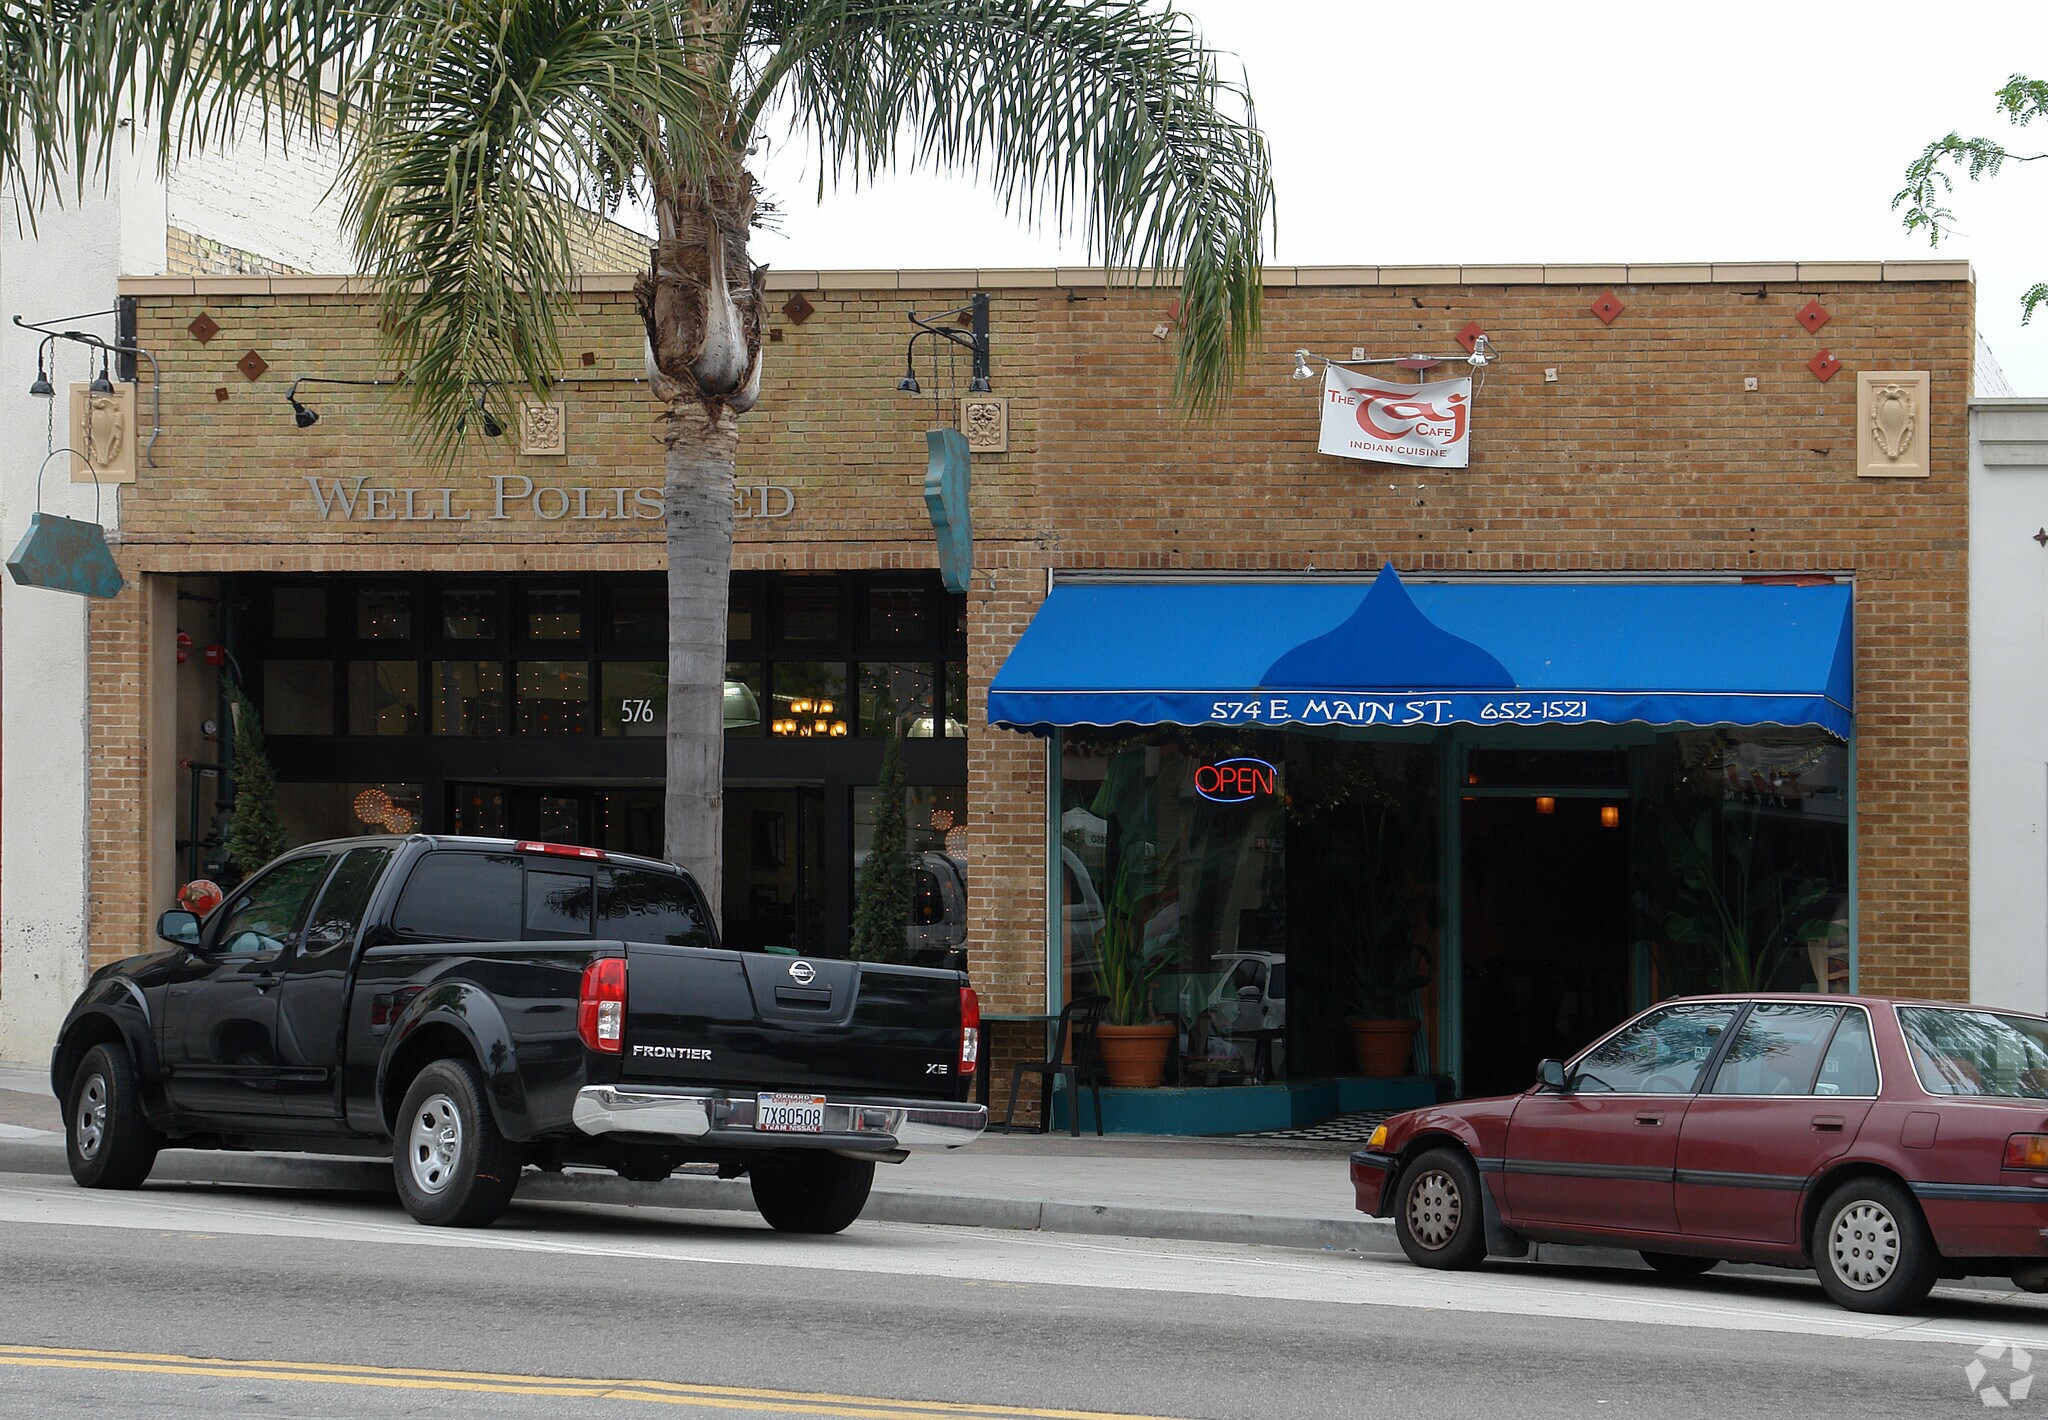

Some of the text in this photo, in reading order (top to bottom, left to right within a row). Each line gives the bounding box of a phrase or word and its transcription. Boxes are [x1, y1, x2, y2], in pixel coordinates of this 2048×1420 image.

[1347, 387, 1469, 445] Taj
[1349, 440, 1447, 458] INDIAN CUISINE
[304, 474, 796, 521] WELL POLISED
[621, 699, 654, 722] 576
[1210, 699, 1588, 724] 574 E. MAIN ST. 652-1521
[1195, 765, 1274, 795] OPEN
[632, 1044, 713, 1061] FRONTIER
[925, 1063, 949, 1075] XE
[762, 1106, 821, 1126] 7X80508
